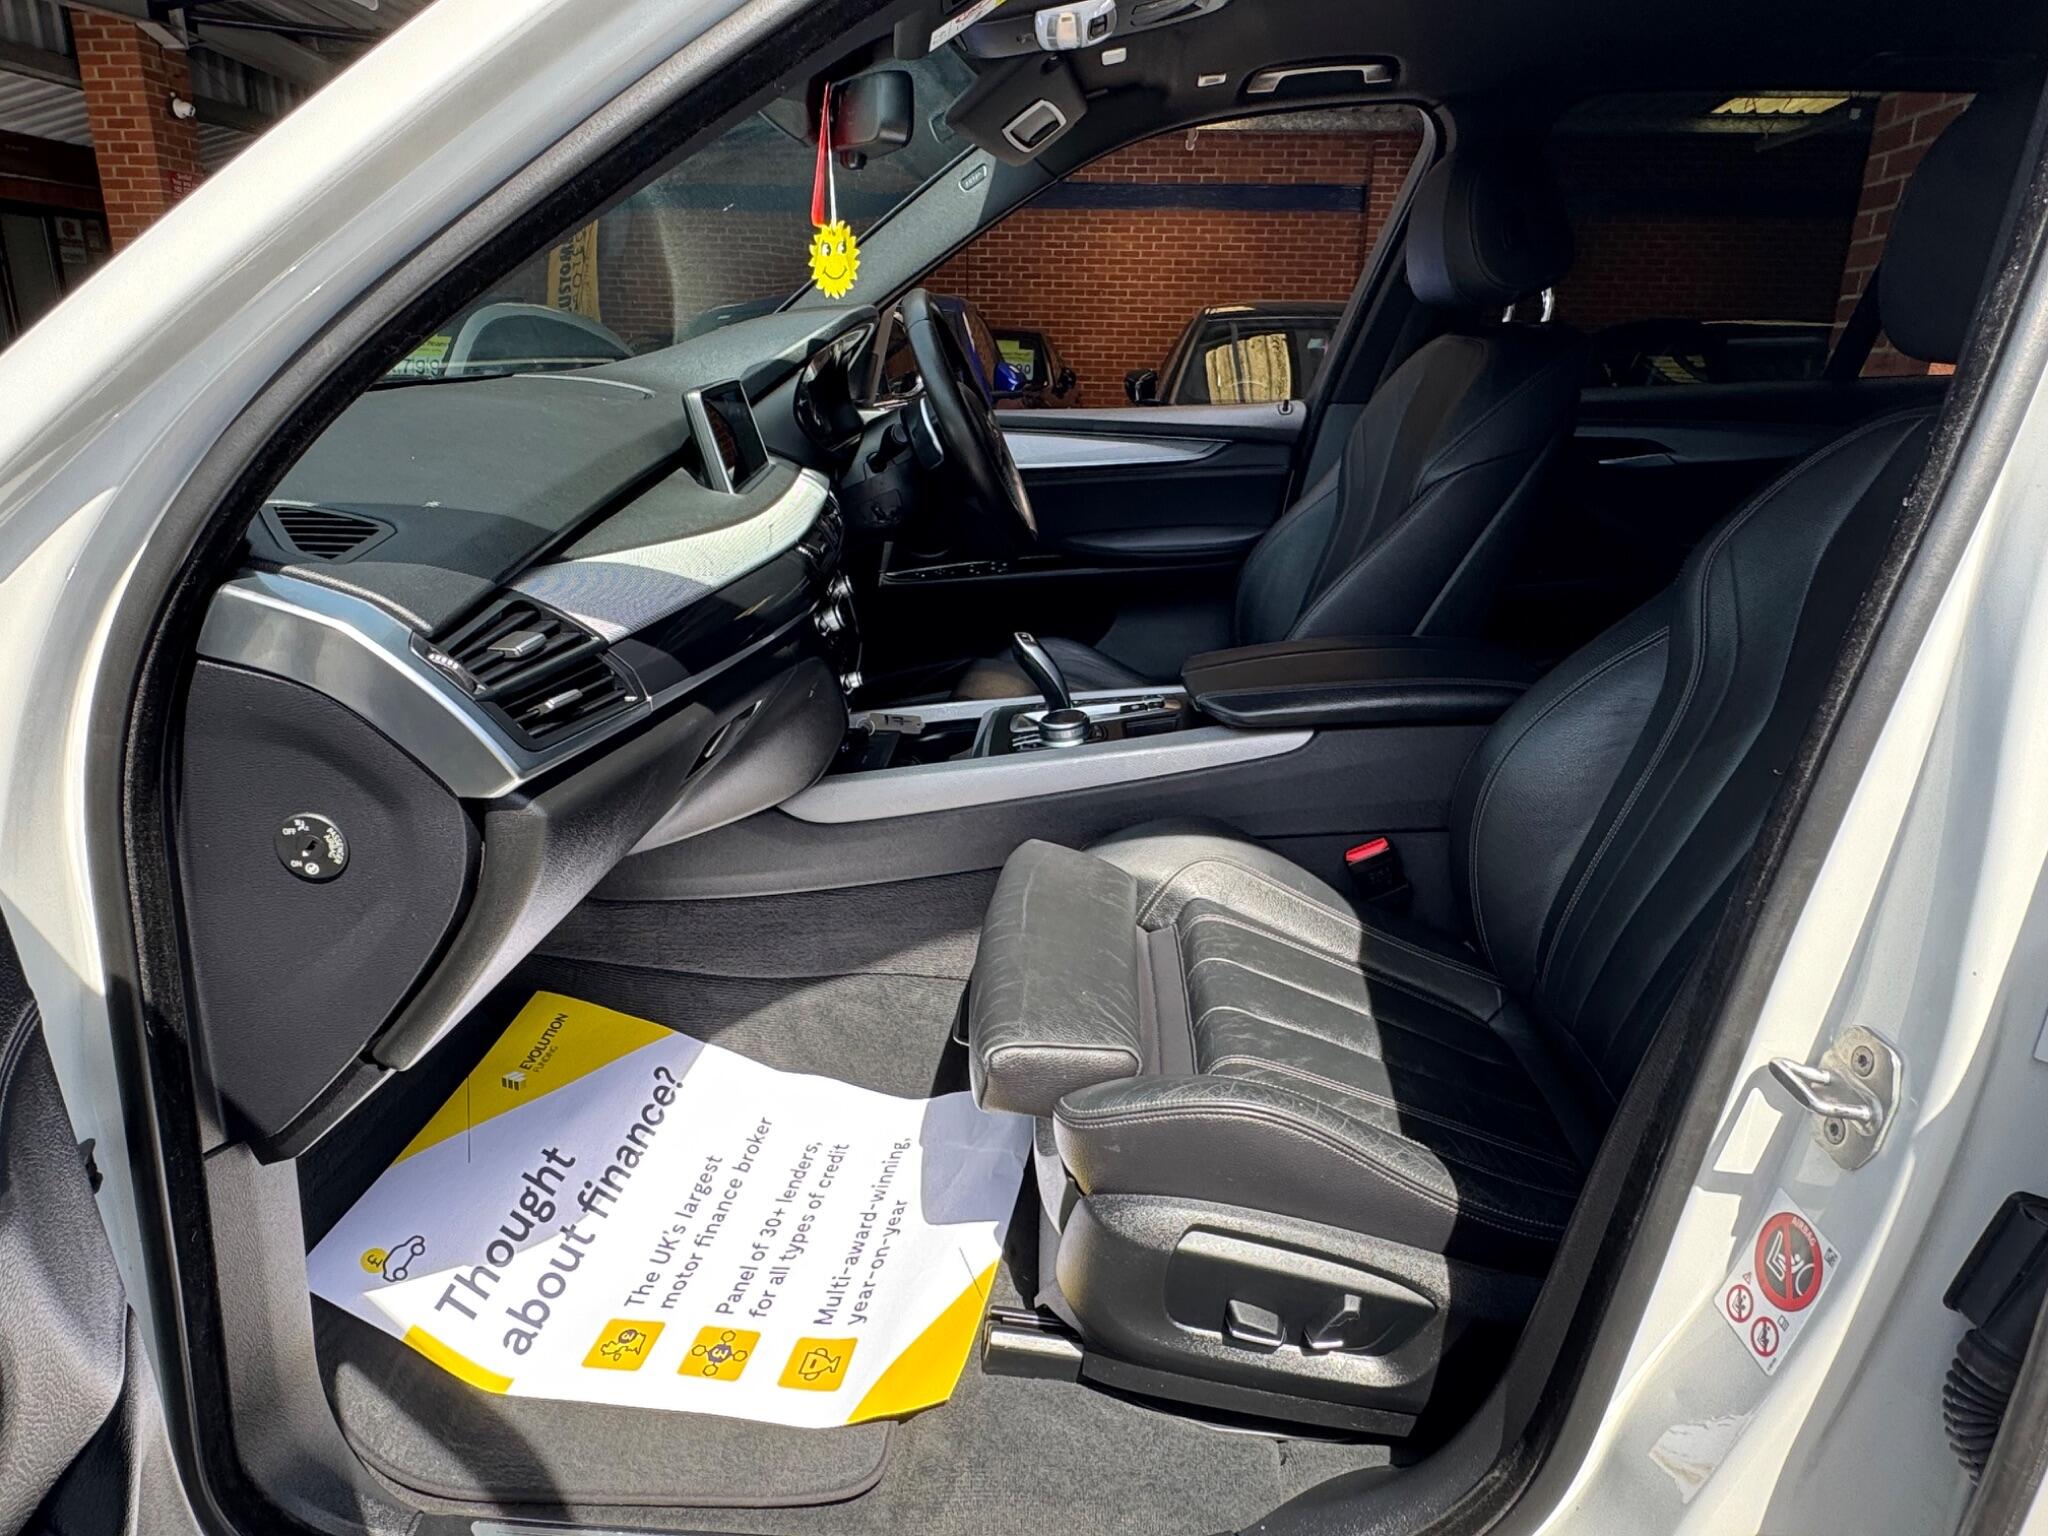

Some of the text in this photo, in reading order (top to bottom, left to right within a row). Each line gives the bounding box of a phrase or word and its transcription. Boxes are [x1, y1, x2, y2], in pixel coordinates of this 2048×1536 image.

[282, 827, 297, 836] OFF
[290, 860, 303, 868] ON
[519, 1012, 569, 1071] EVOLUTION
[533, 1046, 559, 1073] FUNDING
[434, 1146, 576, 1321] Thought
[503, 1065, 684, 1356] about finance?
[624, 1154, 724, 1308] The UK's largest
[661, 1116, 773, 1310] motor finance broker
[715, 1141, 823, 1315] Panel of 30+ lenders,
[748, 1143, 850, 1318] for all types of credit
[813, 1137, 912, 1325] Multi-award-winning,
[847, 1199, 908, 1326] year-on-year
[1791, 1216, 1817, 1247] AIRBAG
